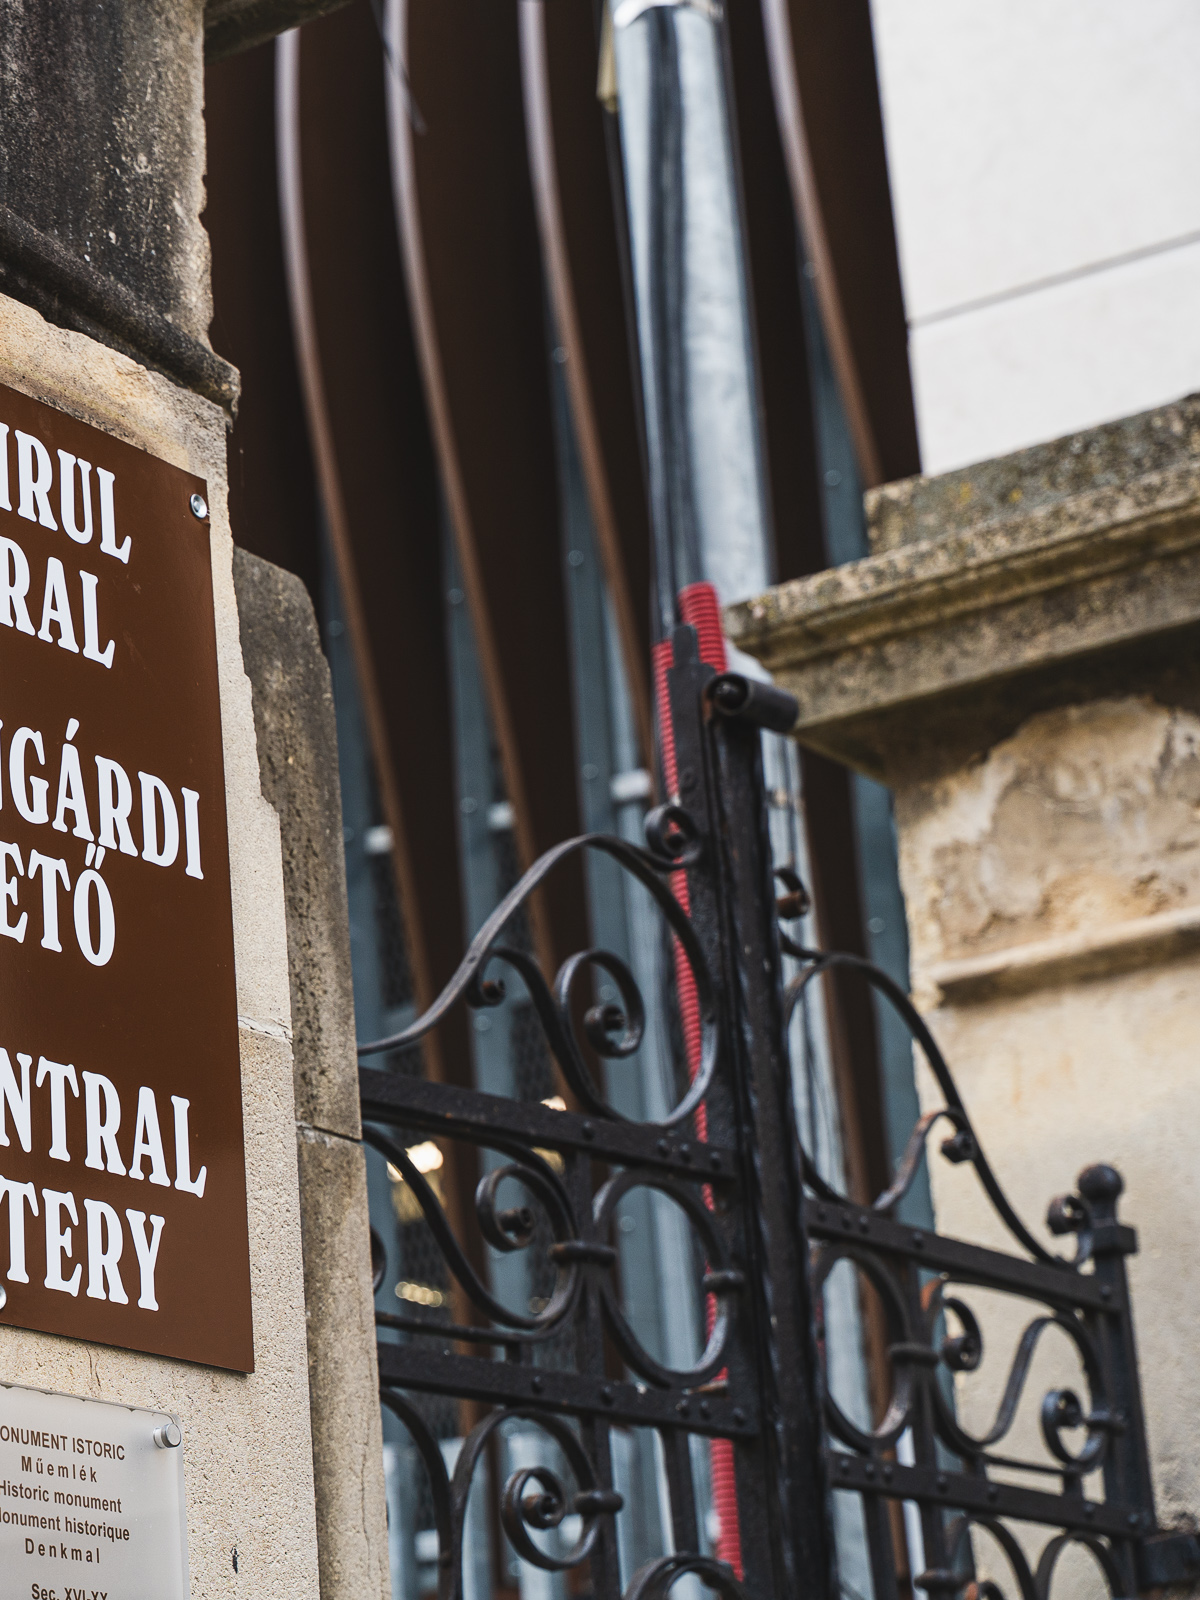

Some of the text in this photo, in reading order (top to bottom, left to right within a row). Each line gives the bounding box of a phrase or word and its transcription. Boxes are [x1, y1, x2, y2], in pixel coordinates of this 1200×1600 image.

[72, 1437, 126, 1461] ISTORIC
[21, 1455, 98, 1483] Műemlék
[53, 1491, 122, 1514] monument
[64, 1516, 130, 1543] historique
[24, 1537, 100, 1564] Denkmal
